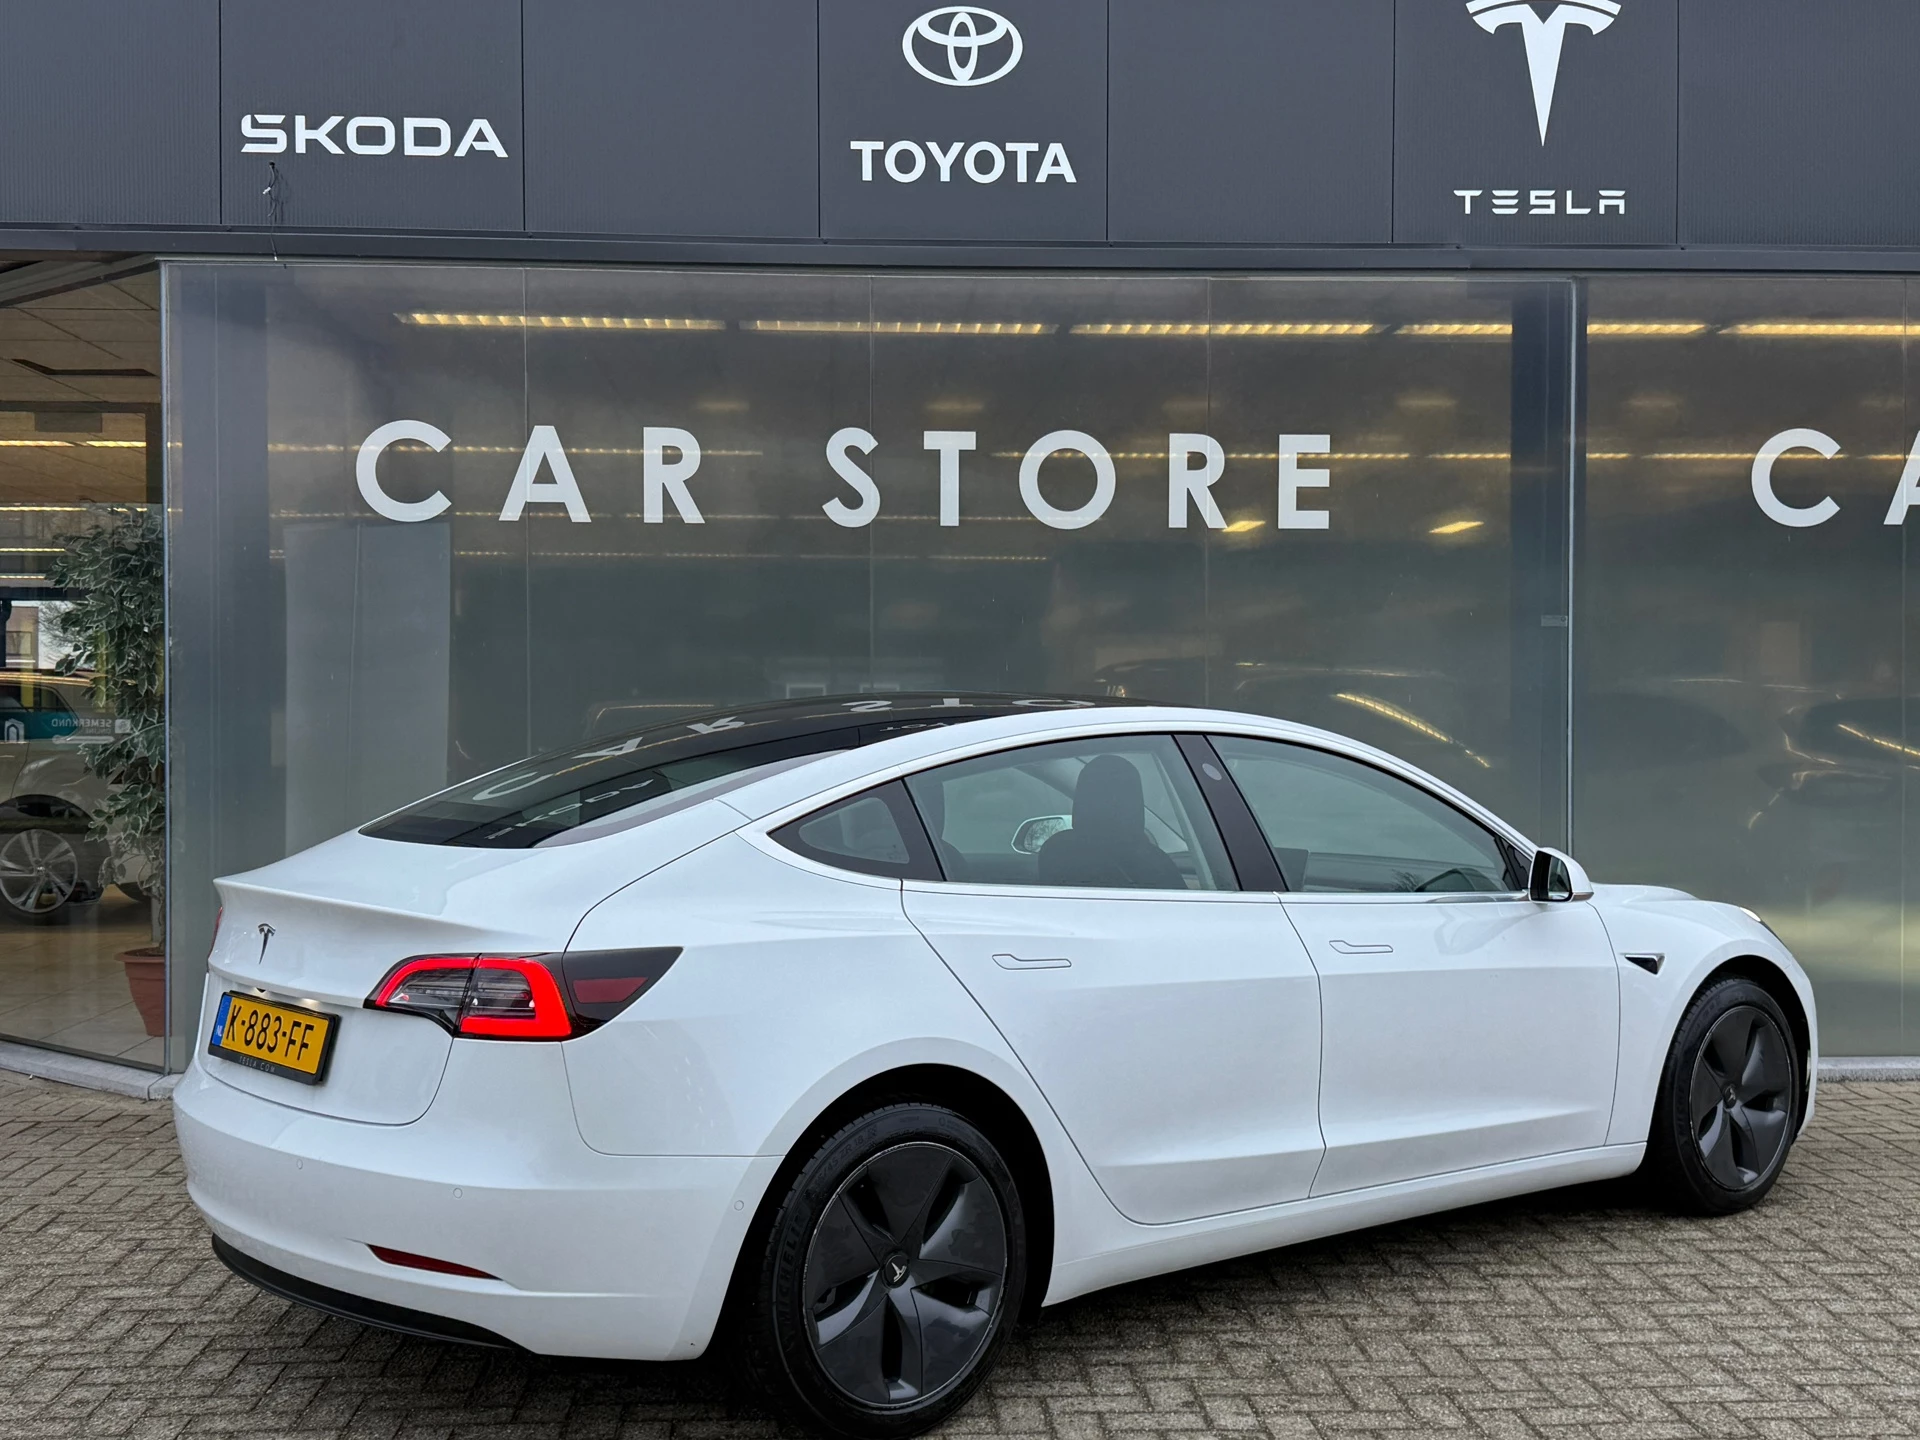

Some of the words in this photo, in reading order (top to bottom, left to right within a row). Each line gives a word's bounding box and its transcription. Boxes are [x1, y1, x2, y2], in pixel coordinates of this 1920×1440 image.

[240, 114, 508, 158] SKODA
[850, 140, 1077, 184] TOYOTA
[1453, 189, 1626, 215] TESLA
[355, 419, 706, 524] CAR
[822, 427, 1332, 531] STORE
[226, 1004, 315, 1061] K-883-FF
